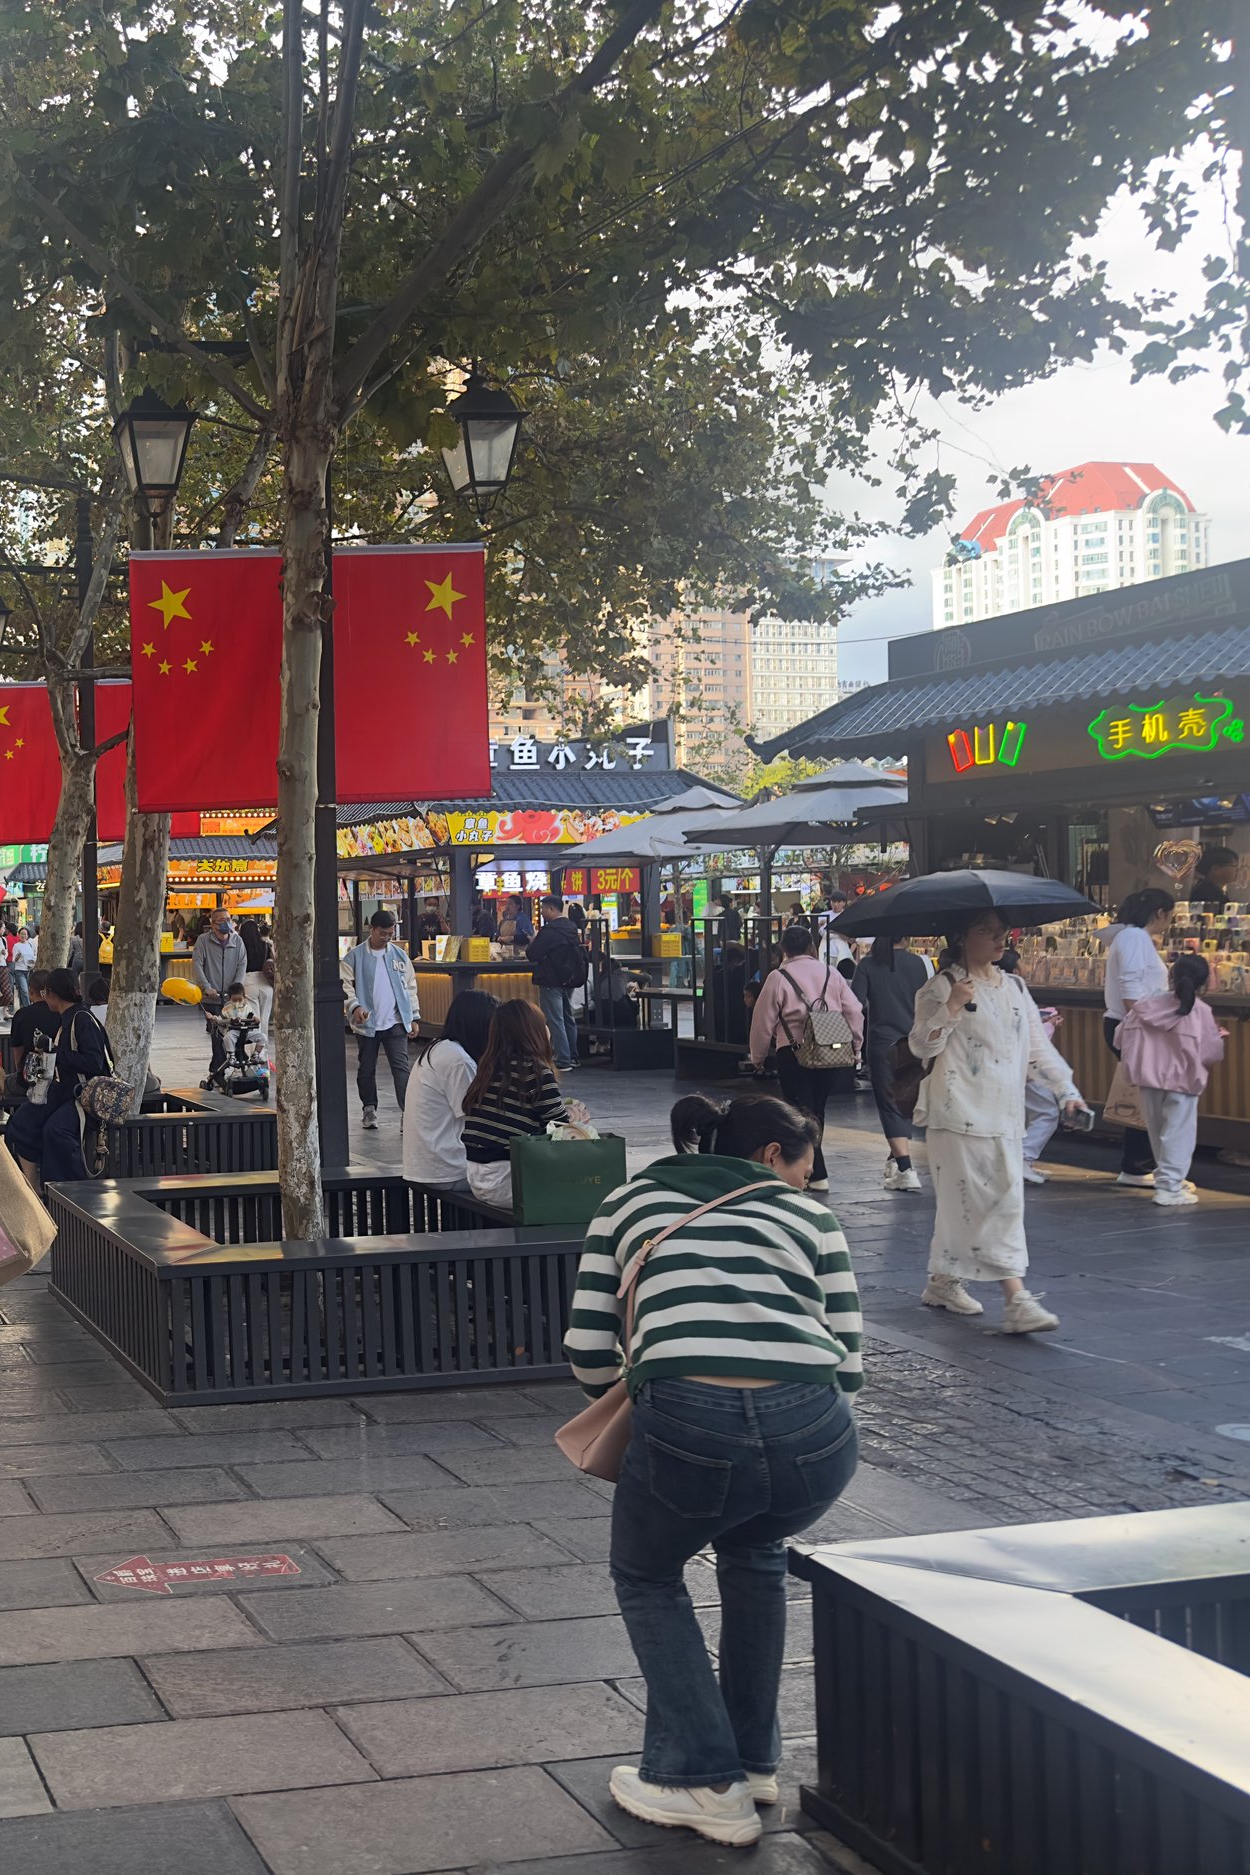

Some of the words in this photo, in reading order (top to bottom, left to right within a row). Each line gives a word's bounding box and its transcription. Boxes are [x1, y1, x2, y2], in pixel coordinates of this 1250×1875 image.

[1108, 707, 1207, 750] 手机壳
[463, 817, 489, 829] 章鱼
[456, 830, 493, 842] 小丸子
[475, 871, 548, 892] 章鱼烧
[597, 868, 634, 890] 3元/个
[166, 1559, 283, 1578] 进店享好礼
